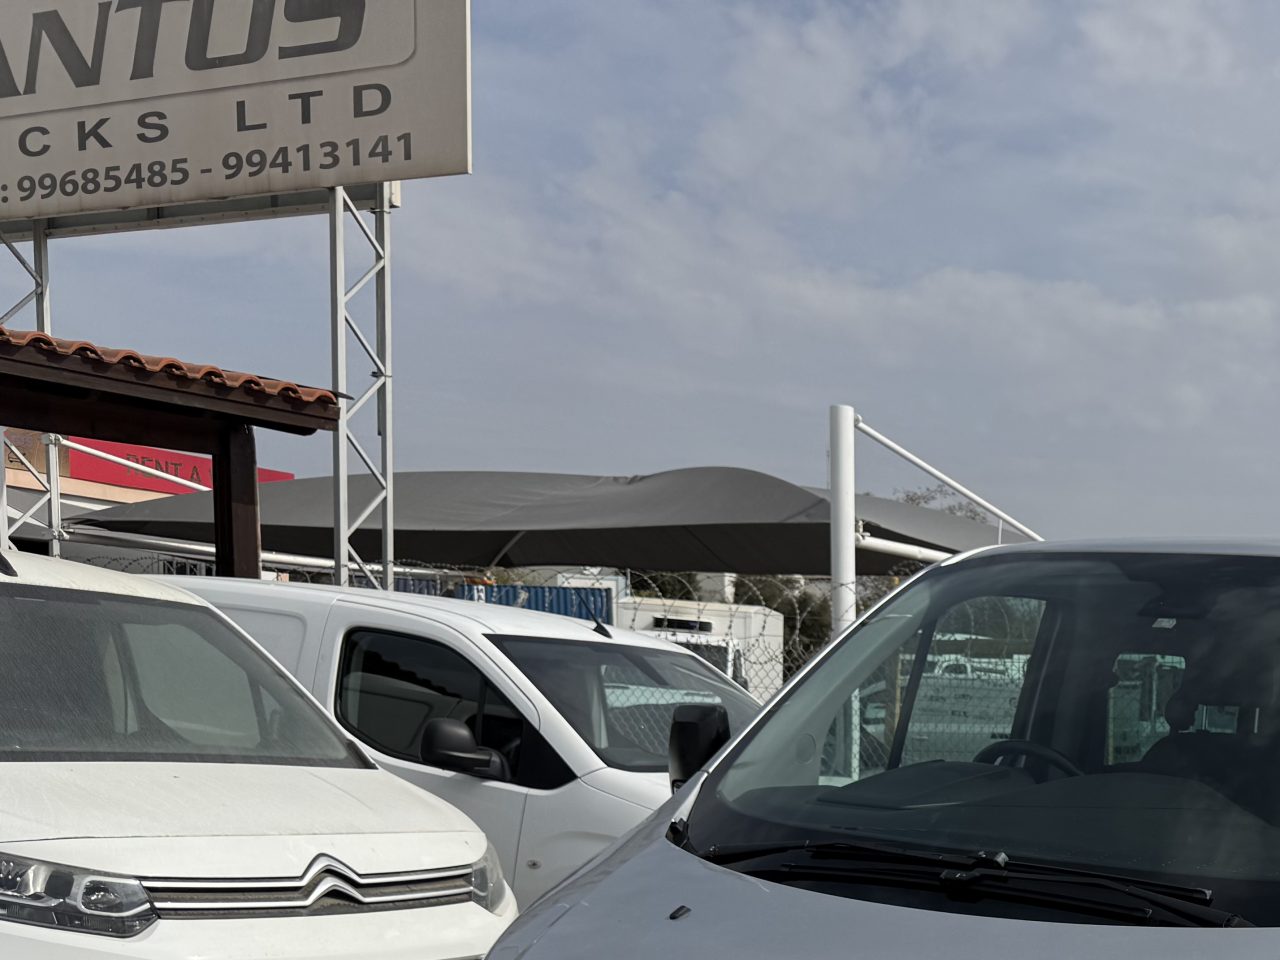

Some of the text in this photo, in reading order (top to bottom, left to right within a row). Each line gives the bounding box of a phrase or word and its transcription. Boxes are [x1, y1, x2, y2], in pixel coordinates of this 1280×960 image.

[236, 83, 392, 132] LTD
[19, 158, 189, 201] 99685485
[222, 132, 412, 180] 99413141
